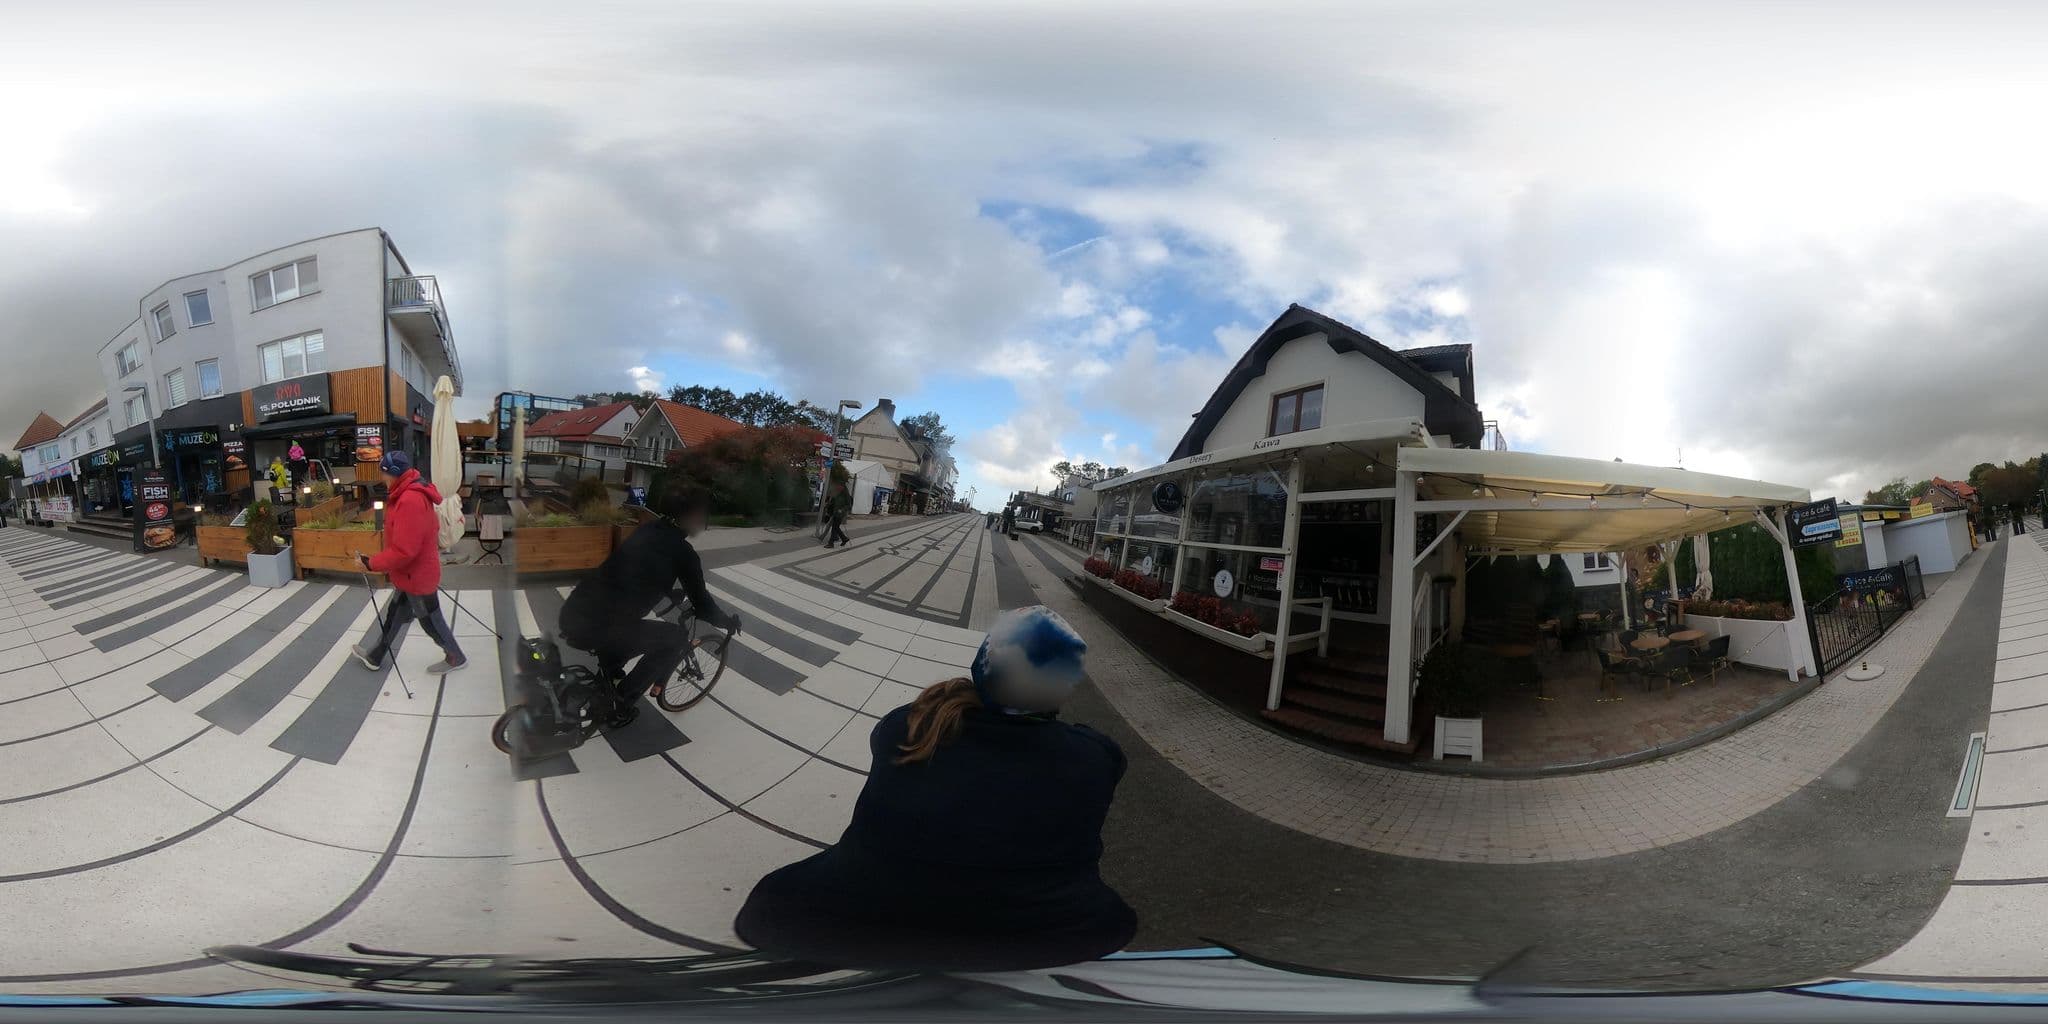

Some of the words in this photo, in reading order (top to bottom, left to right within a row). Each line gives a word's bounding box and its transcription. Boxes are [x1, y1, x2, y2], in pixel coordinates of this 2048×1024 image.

[271, 395, 321, 410] POŁUDNIK
[179, 432, 218, 446] MUZEON
[1253, 439, 1280, 450] Kawa
[91, 449, 120, 467] MUZEON
[143, 486, 169, 496] FISH
